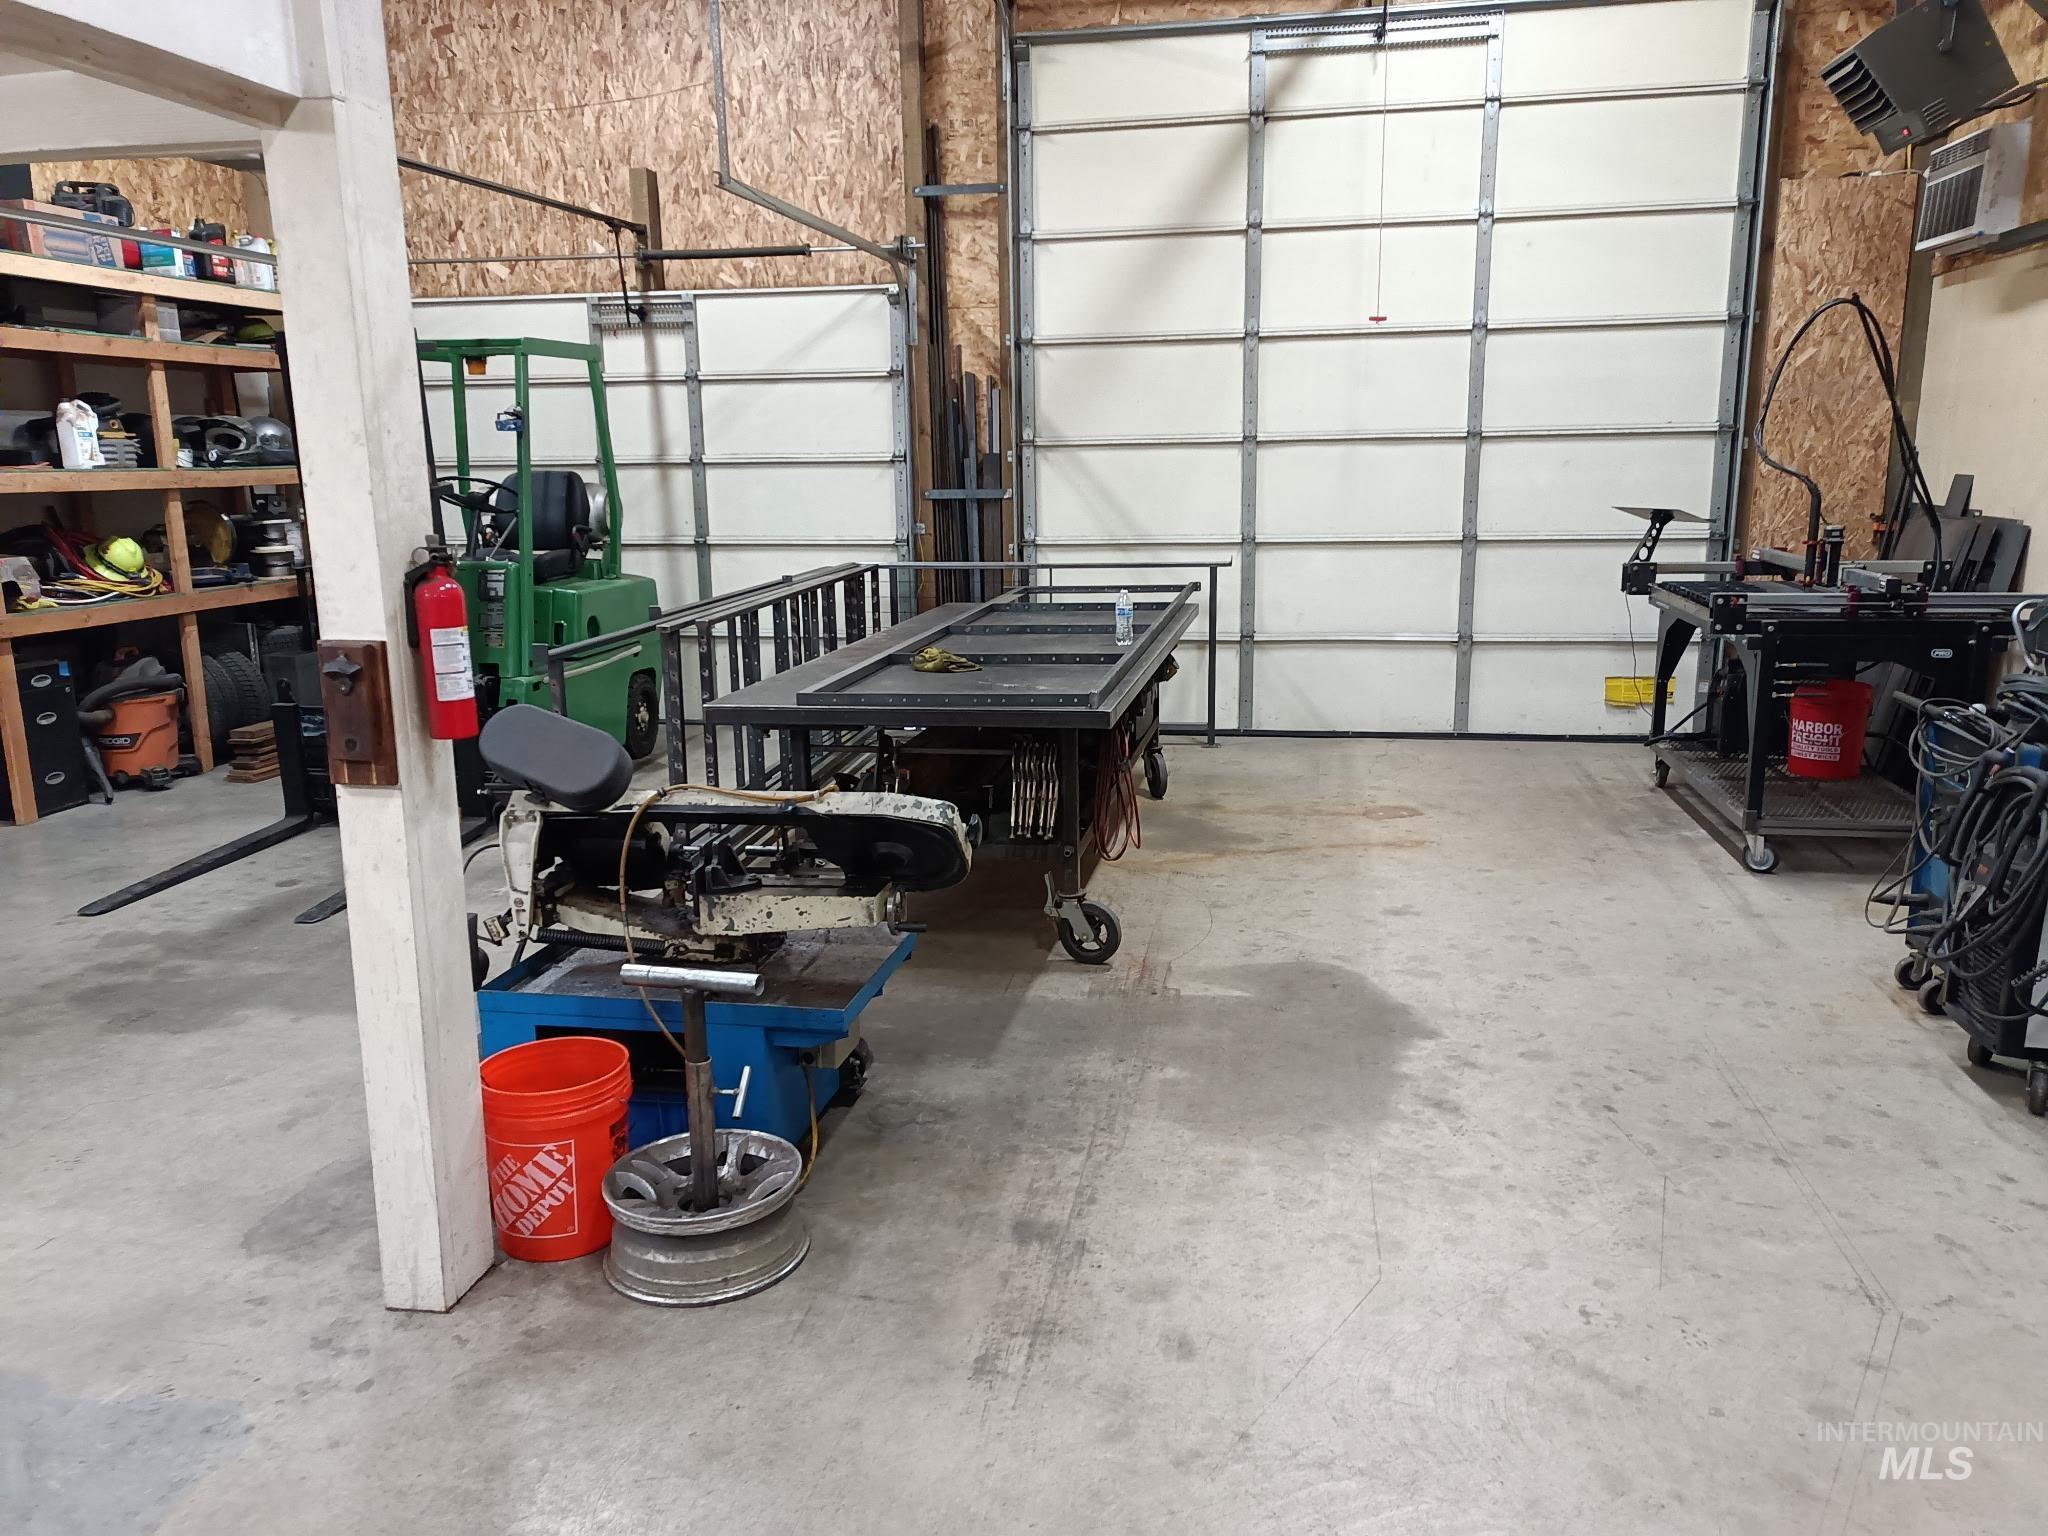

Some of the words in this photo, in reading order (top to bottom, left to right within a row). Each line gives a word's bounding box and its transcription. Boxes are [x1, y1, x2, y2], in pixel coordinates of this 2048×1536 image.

[1791, 730, 1841, 747] FREIGHT
[1792, 718, 1842, 735] HARBOR
[491, 1153, 520, 1185] THE
[493, 1145, 575, 1231] HOME
[515, 1177, 574, 1236] DEPOT
